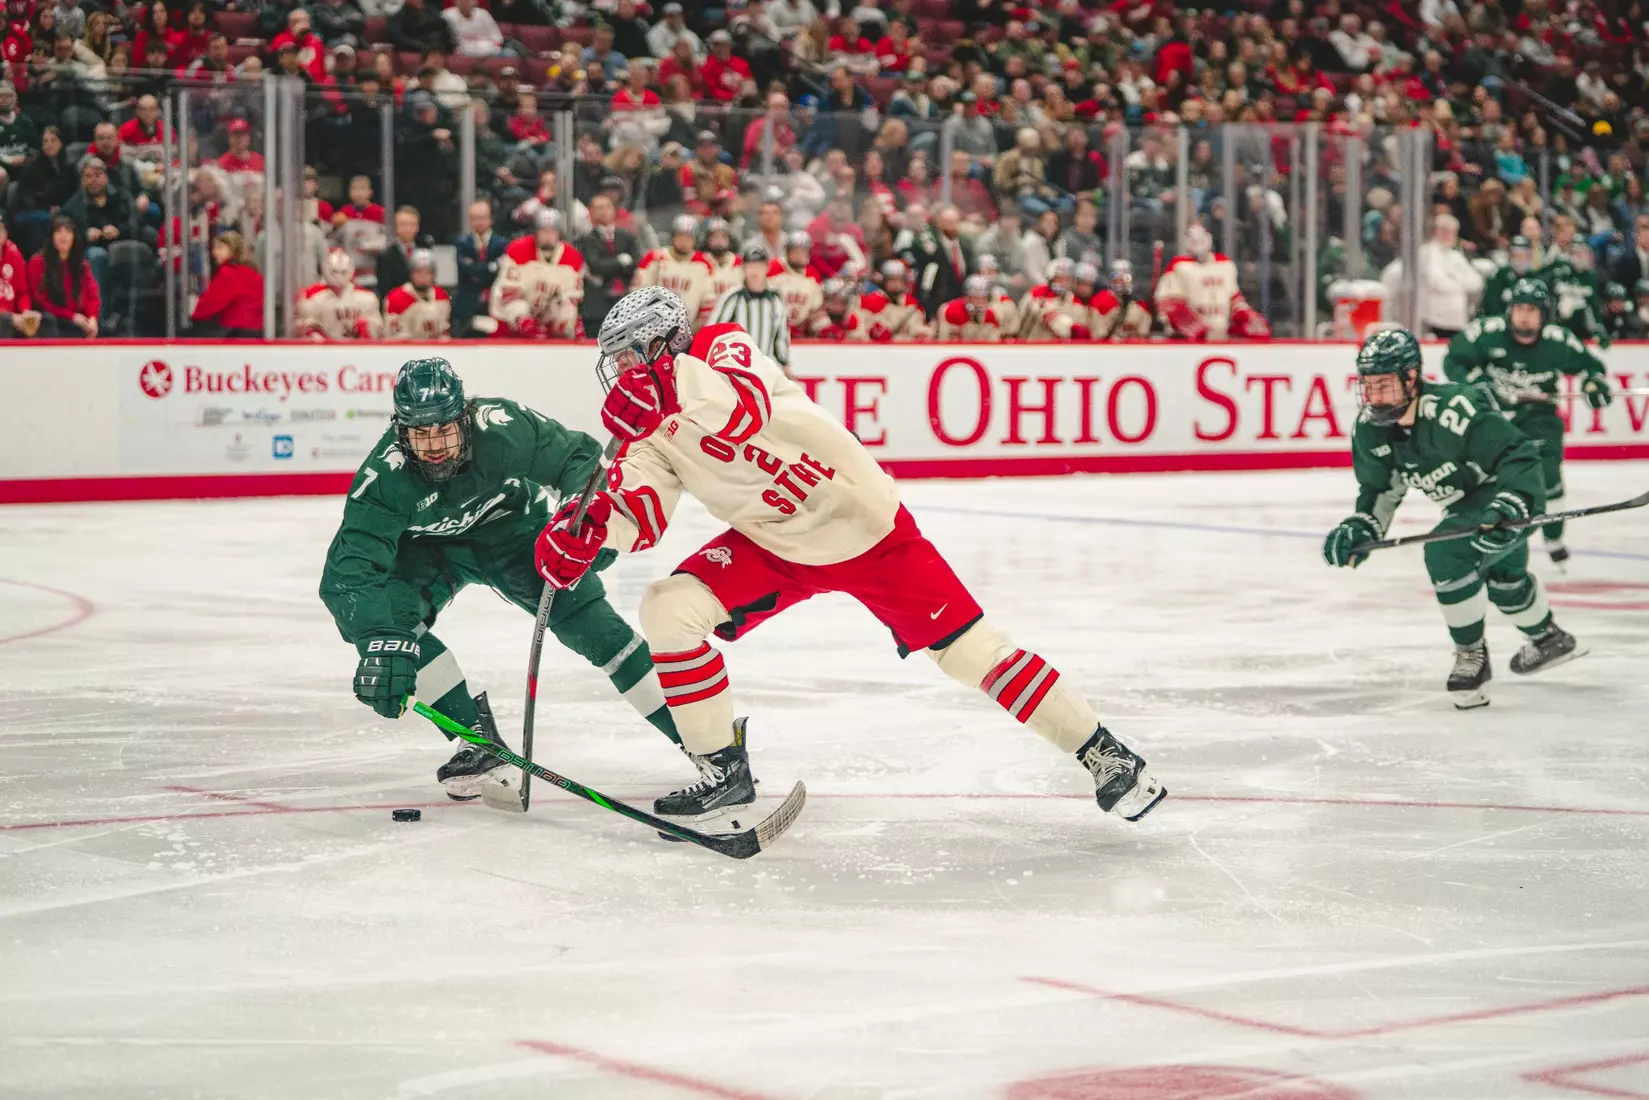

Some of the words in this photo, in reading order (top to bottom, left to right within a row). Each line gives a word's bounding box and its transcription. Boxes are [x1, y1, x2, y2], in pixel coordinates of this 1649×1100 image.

[708, 342, 752, 368] 23
[184, 363, 328, 403] Buckeyes
[337, 364, 397, 394] Car
[419, 387, 430, 402] 7
[1193, 356, 1357, 442] STA
[1439, 395, 1477, 436] 27
[743, 443, 783, 476] 2
[350, 467, 379, 499] 7
[367, 640, 420, 658] BAUE
